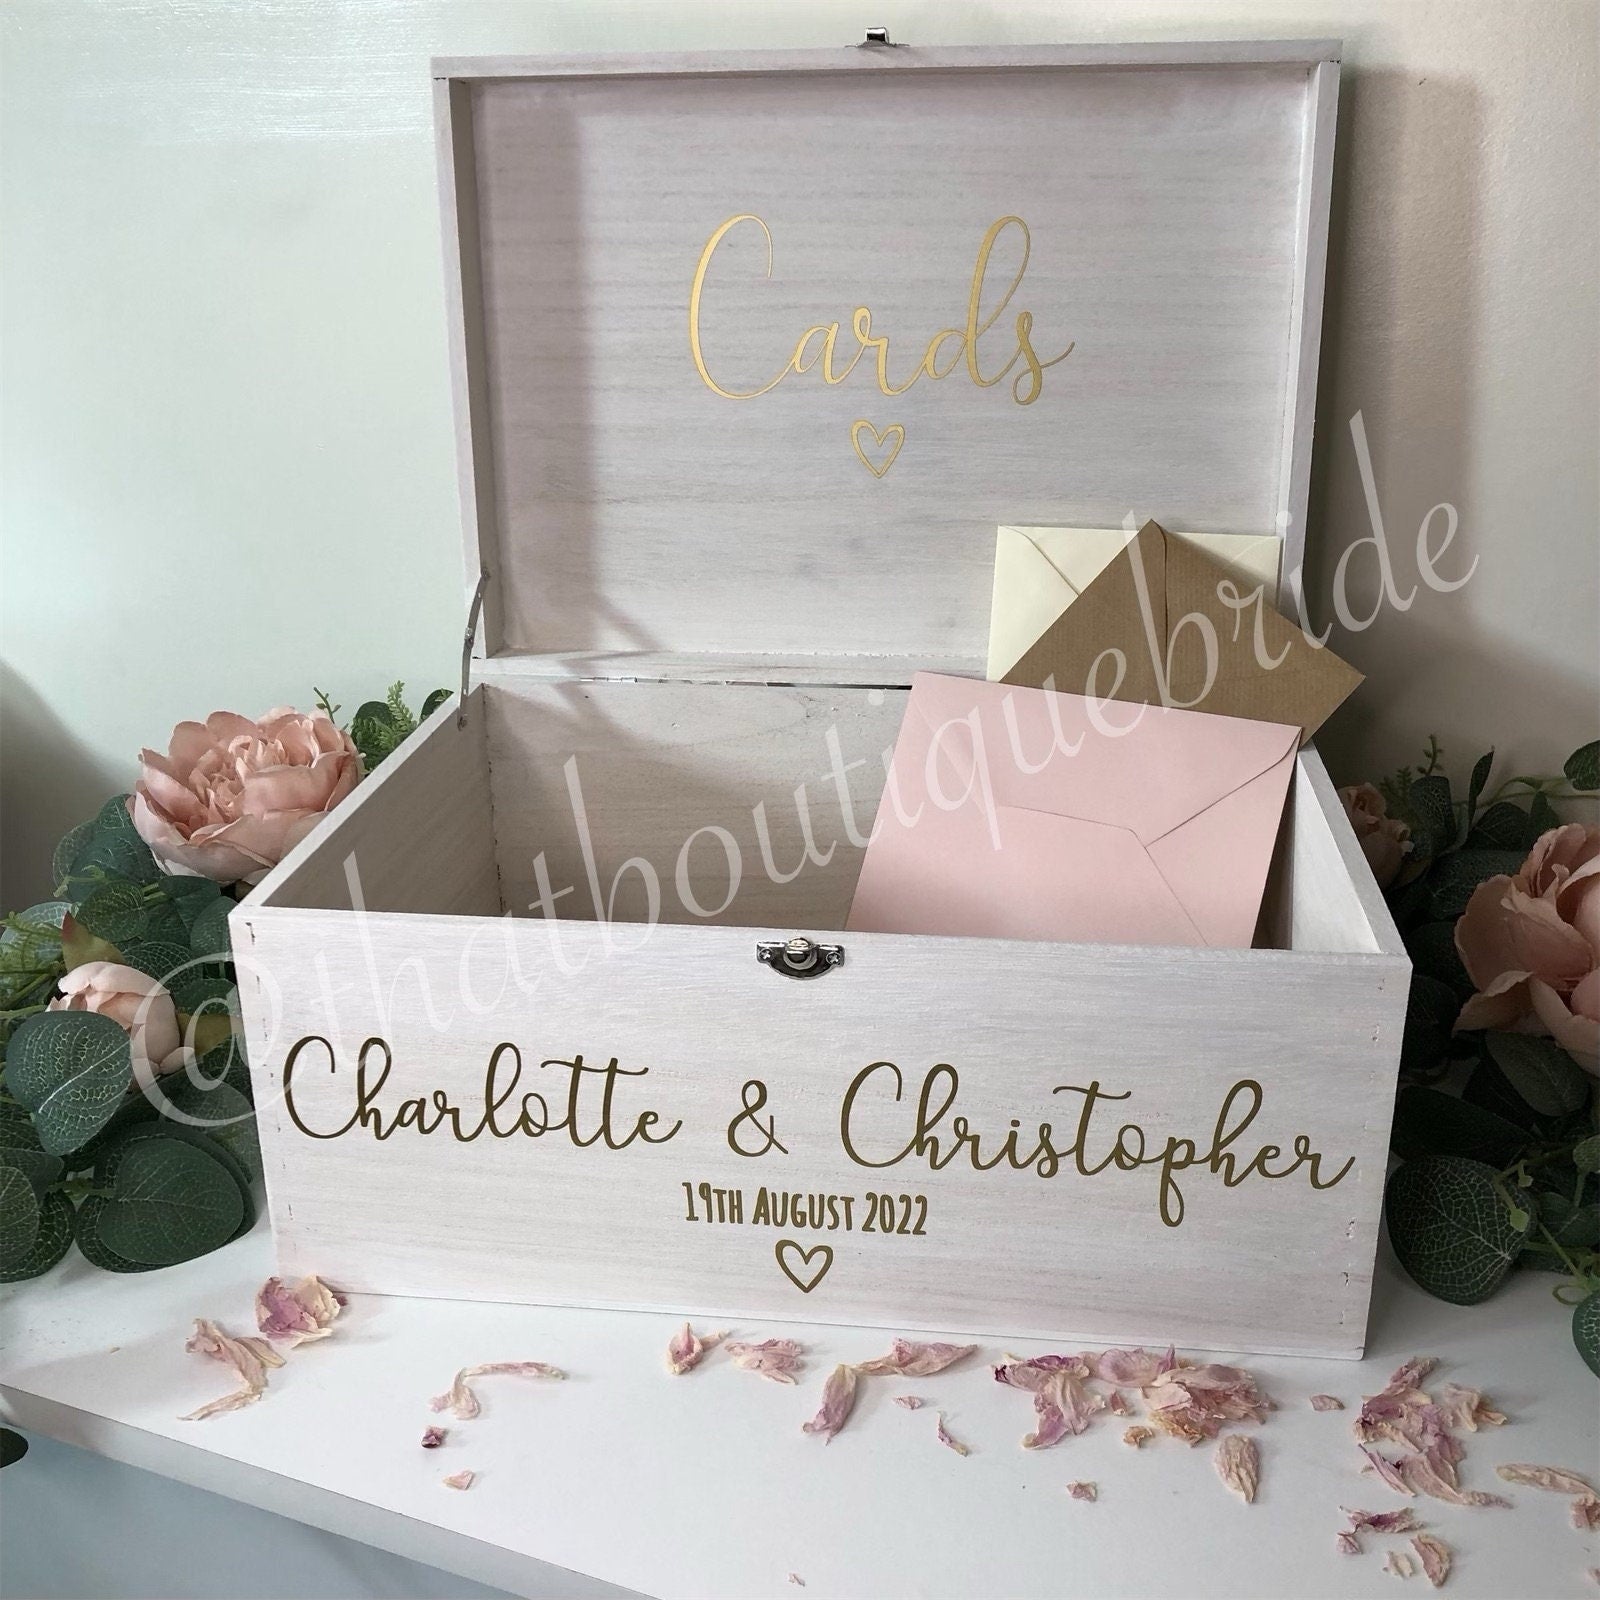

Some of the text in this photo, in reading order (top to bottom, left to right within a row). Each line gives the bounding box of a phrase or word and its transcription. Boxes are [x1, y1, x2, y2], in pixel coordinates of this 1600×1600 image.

[689, 213, 1075, 406] Cards
[282, 1035, 1356, 1228] Charlotte & Christopher
[681, 1181, 928, 1236] 19TH AUGUST 2022
